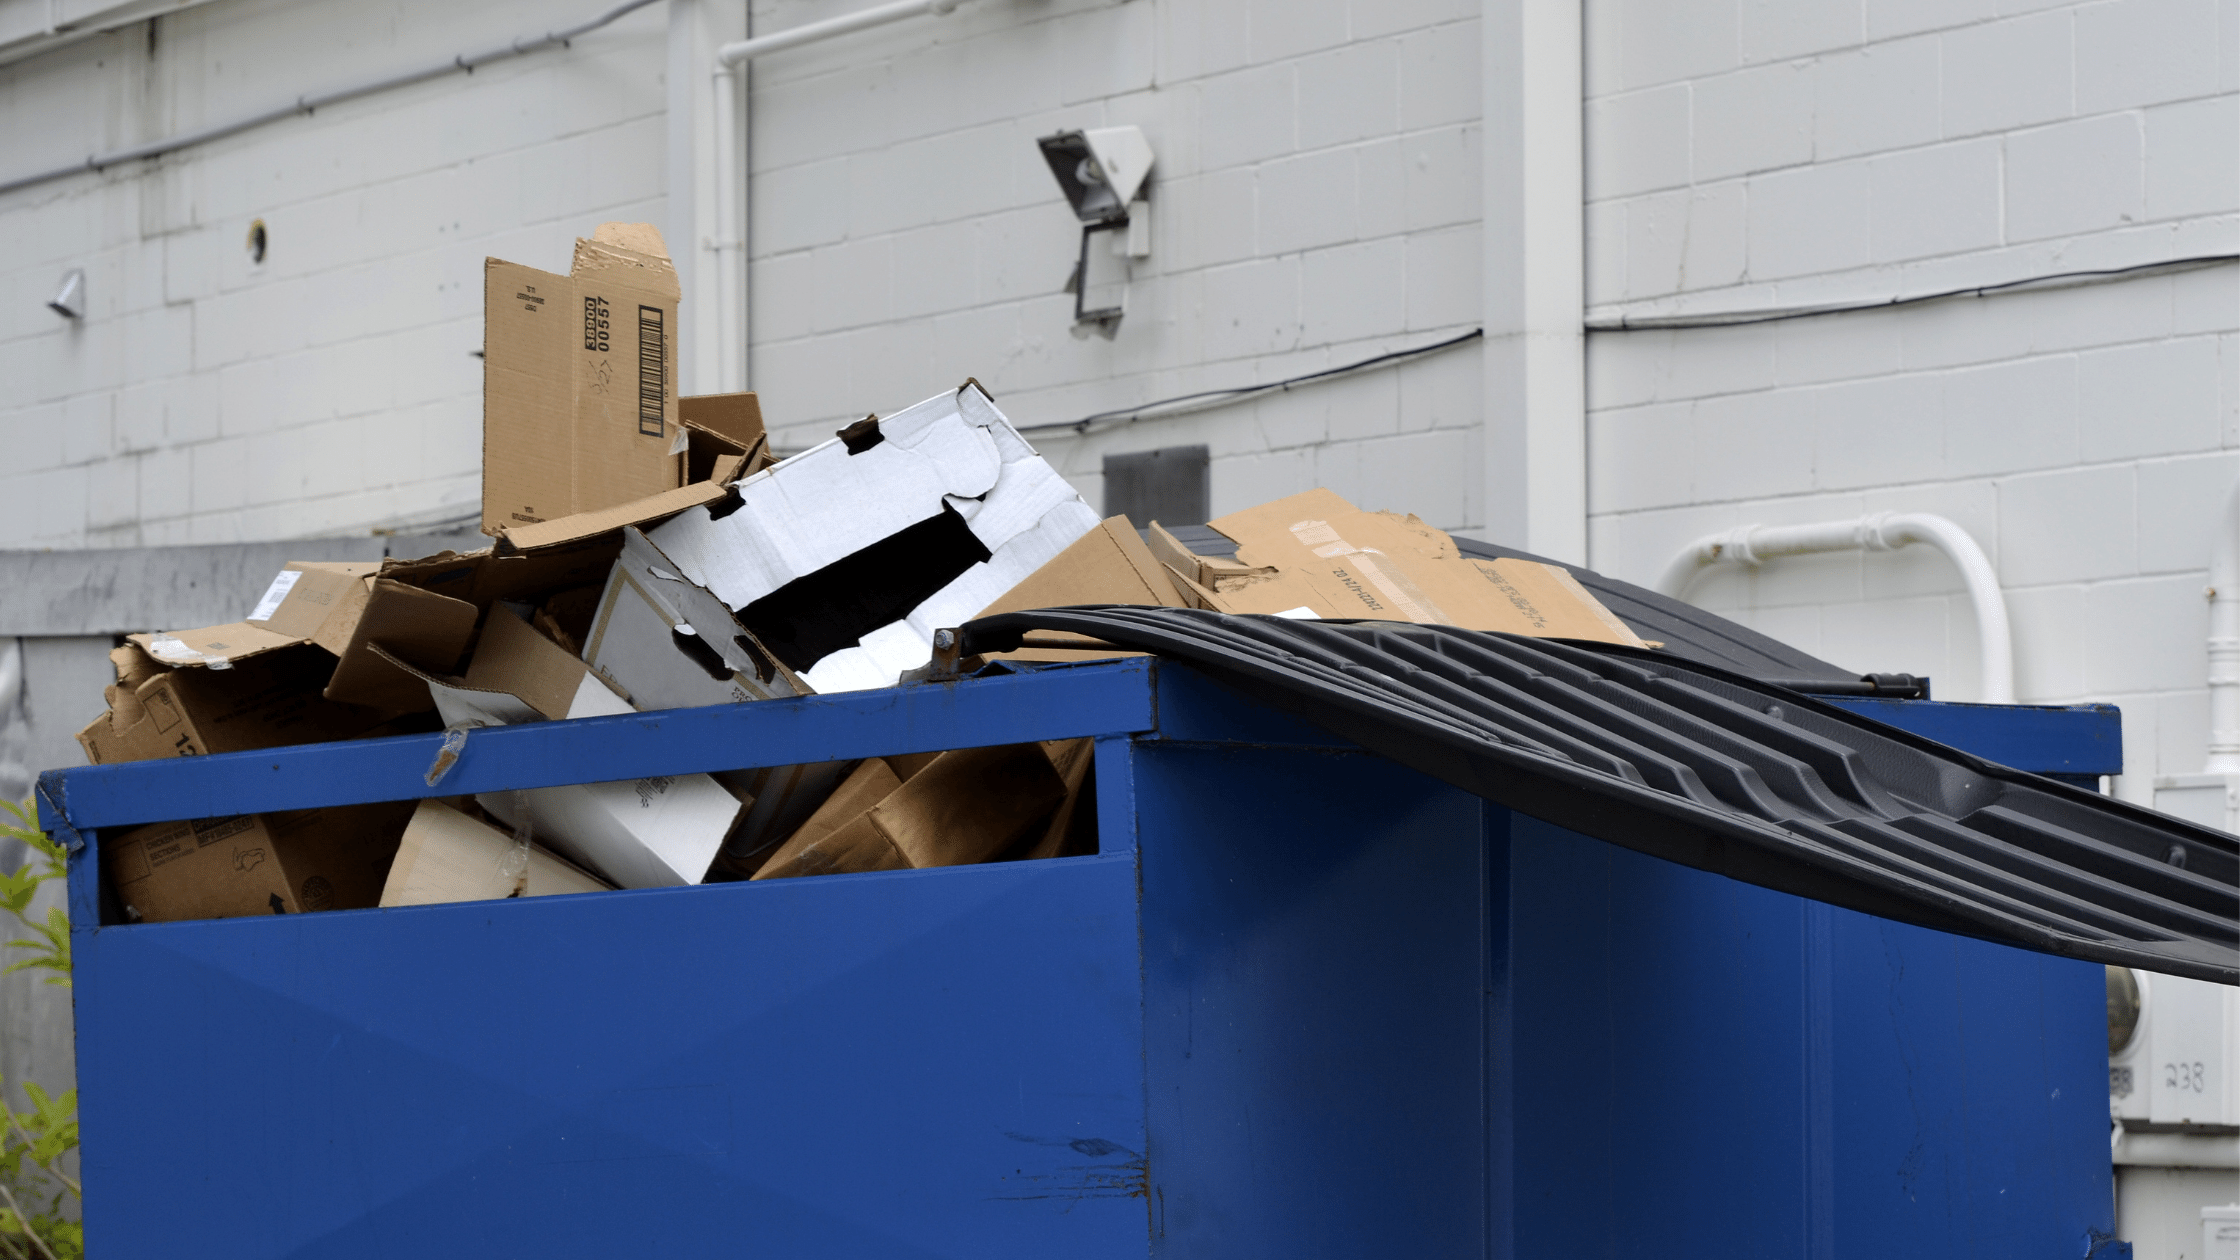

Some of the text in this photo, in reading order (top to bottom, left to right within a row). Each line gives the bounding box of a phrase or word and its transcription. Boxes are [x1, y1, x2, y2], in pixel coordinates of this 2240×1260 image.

[584, 296, 597, 351] 38900
[597, 296, 610, 352] 00557
[149, 843, 181, 861] SECTIONS
[2164, 1061, 2205, 1094] 238
